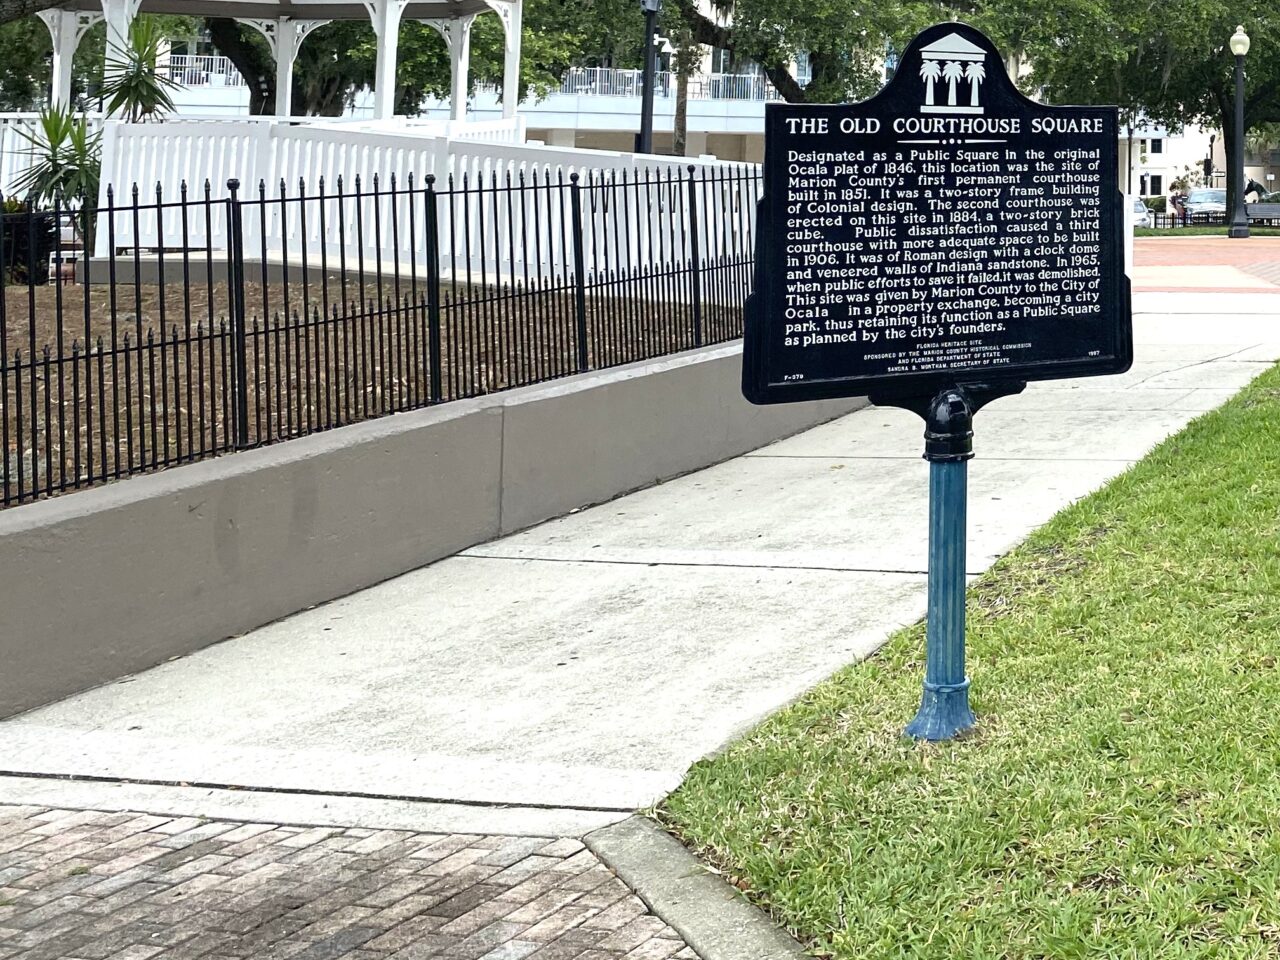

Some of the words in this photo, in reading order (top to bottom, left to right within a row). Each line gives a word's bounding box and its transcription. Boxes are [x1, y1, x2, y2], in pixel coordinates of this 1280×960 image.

[785, 118, 828, 134] THE
[840, 118, 880, 134] OLD
[893, 118, 1020, 133] COURTHOUSE
[1032, 117, 1102, 134] SQUARE
[788, 150, 864, 164] Designated
[872, 152, 886, 160] as
[895, 152, 902, 160] a
[910, 149, 949, 160] Public
[956, 149, 998, 162] Square
[1005, 149, 1016, 159] in
[1025, 149, 1044, 159] the
[1054, 148, 1099, 162] original
[788, 163, 827, 174] Ocala
[834, 163, 858, 176] plat
[863, 163, 877, 173] of
[922, 162, 945, 172] this
[950, 162, 999, 172] location
[1007, 163, 1028, 171] was
[1035, 160, 1054, 171] the
[1062, 161, 1081, 170] site
[1088, 160, 1099, 170] of
[788, 177, 836, 187] Marion
[918, 175, 944, 185] first
[956, 174, 1020, 187] permanent
[1032, 172, 1099, 183] courthouse
[788, 190, 818, 200] built
[824, 190, 836, 199] in
[841, 189, 870, 199] 1851.
[881, 189, 889, 199] It
[896, 190, 918, 198] was
[924, 190, 932, 198] a
[939, 188, 1000, 200] two-story
[1009, 186, 1044, 196] frame
[1052, 185, 1099, 197] building
[787, 203, 801, 213] of
[807, 201, 864, 212] Colonial
[870, 201, 917, 213] design.
[928, 199, 952, 210] The
[956, 198, 998, 209] second
[1006, 197, 1072, 208] courthouse
[1080, 198, 1099, 206] was
[787, 215, 842, 226] erected
[850, 216, 865, 224] on
[871, 213, 895, 224] this
[903, 213, 926, 223] site
[932, 213, 943, 222] in
[986, 213, 992, 221] a
[1000, 210, 1062, 222] two-story
[1070, 208, 1099, 219] brick
[787, 228, 824, 239] cube.
[855, 227, 896, 237] Public
[908, 224, 997, 236] dissatisfaction
[1006, 222, 1047, 233] caused
[1056, 223, 1062, 231] a
[1069, 220, 1099, 231] third
[786, 241, 863, 252] courthouse
[869, 238, 896, 249] with
[902, 240, 934, 248] more
[939, 236, 996, 249] adequate
[999, 236, 1033, 248] space
[1037, 234, 1049, 244] to
[1054, 233, 1068, 243] be
[1072, 232, 1099, 243] built
[787, 255, 798, 265] in
[804, 253, 838, 264] 1906.
[846, 253, 854, 263] It
[860, 254, 882, 262] was
[887, 251, 900, 261] of
[904, 251, 945, 261] Roman
[948, 249, 987, 261] design
[993, 246, 1018, 257] with
[1024, 248, 1030, 256] a
[1034, 244, 1064, 255] clock
[1069, 244, 1099, 254] dome
[786, 267, 811, 278] and
[816, 265, 877, 277] veneered
[884, 263, 916, 274] walls
[920, 262, 932, 273] of
[936, 261, 982, 272] Indiana
[987, 259, 1049, 270] sandstone.
[1056, 257, 1067, 267] In
[786, 281, 820, 292] when
[825, 279, 864, 293] public
[868, 277, 910, 288] efforts
[913, 276, 925, 285] to
[928, 276, 953, 285] save
[1014, 272, 1034, 281] was
[1038, 268, 1100, 280] demolished.
[786, 294, 815, 305] This
[820, 293, 842, 303] site
[846, 293, 869, 302] was
[875, 290, 908, 303] given
[912, 288, 927, 301] by
[931, 286, 974, 297] Marion
[978, 284, 1021, 296] County
[1024, 283, 1036, 293] to
[1039, 282, 1058, 292] the
[1061, 281, 1085, 293] City
[1088, 279, 1098, 290] of
[785, 306, 828, 317] Ocala
[848, 305, 860, 314] in
[876, 301, 933, 316] property
[1004, 295, 1060, 307] becoming
[1065, 295, 1071, 303] a
[1076, 292, 1099, 304] city
[824, 319, 852, 329] thus
[858, 315, 917, 327] retaining
[922, 313, 936, 323] its
[940, 310, 992, 322] function
[997, 310, 1009, 319] as
[1012, 310, 1019, 318] a
[1023, 306, 1058, 317] Public
[1060, 305, 1100, 317] Square
[784, 337, 798, 345] as
[803, 331, 856, 347] planned
[862, 330, 878, 343] by
[885, 329, 906, 339] the
[949, 324, 1005, 335] founders.
[863, 352, 896, 360] SPONSORED
